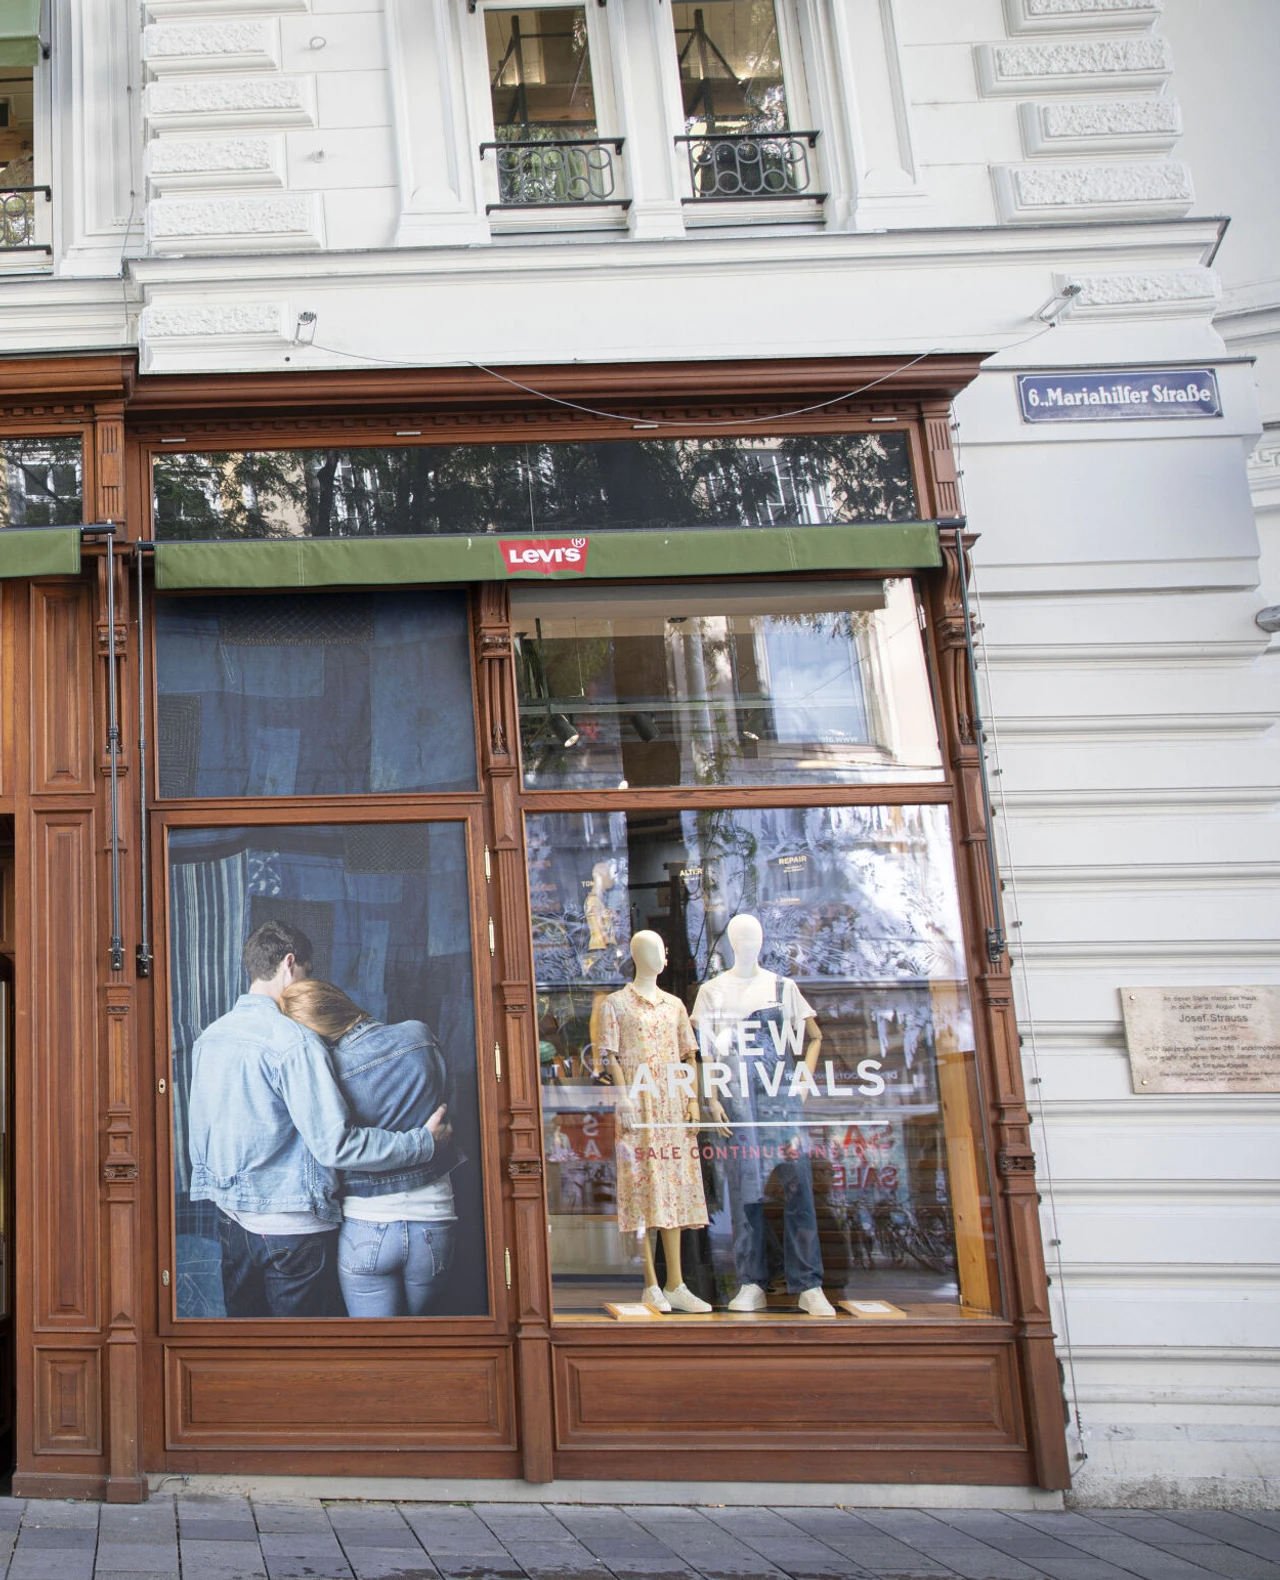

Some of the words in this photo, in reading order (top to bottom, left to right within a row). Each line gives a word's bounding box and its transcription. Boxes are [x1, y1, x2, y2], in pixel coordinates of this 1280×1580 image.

[1047, 386, 1149, 406] Mariahilfer
[1152, 383, 1211, 403] Straße
[778, 855, 808, 865] REPAIR
[1179, 1014, 1208, 1023] Josef
[1210, 1013, 1249, 1022] Strauss
[699, 1019, 807, 1057] NEW
[628, 1058, 886, 1099] ARRIVALS
[634, 1146, 686, 1161] SALE
[690, 1145, 800, 1160] CONTINUES
[808, 1144, 891, 1159] INSTORE
